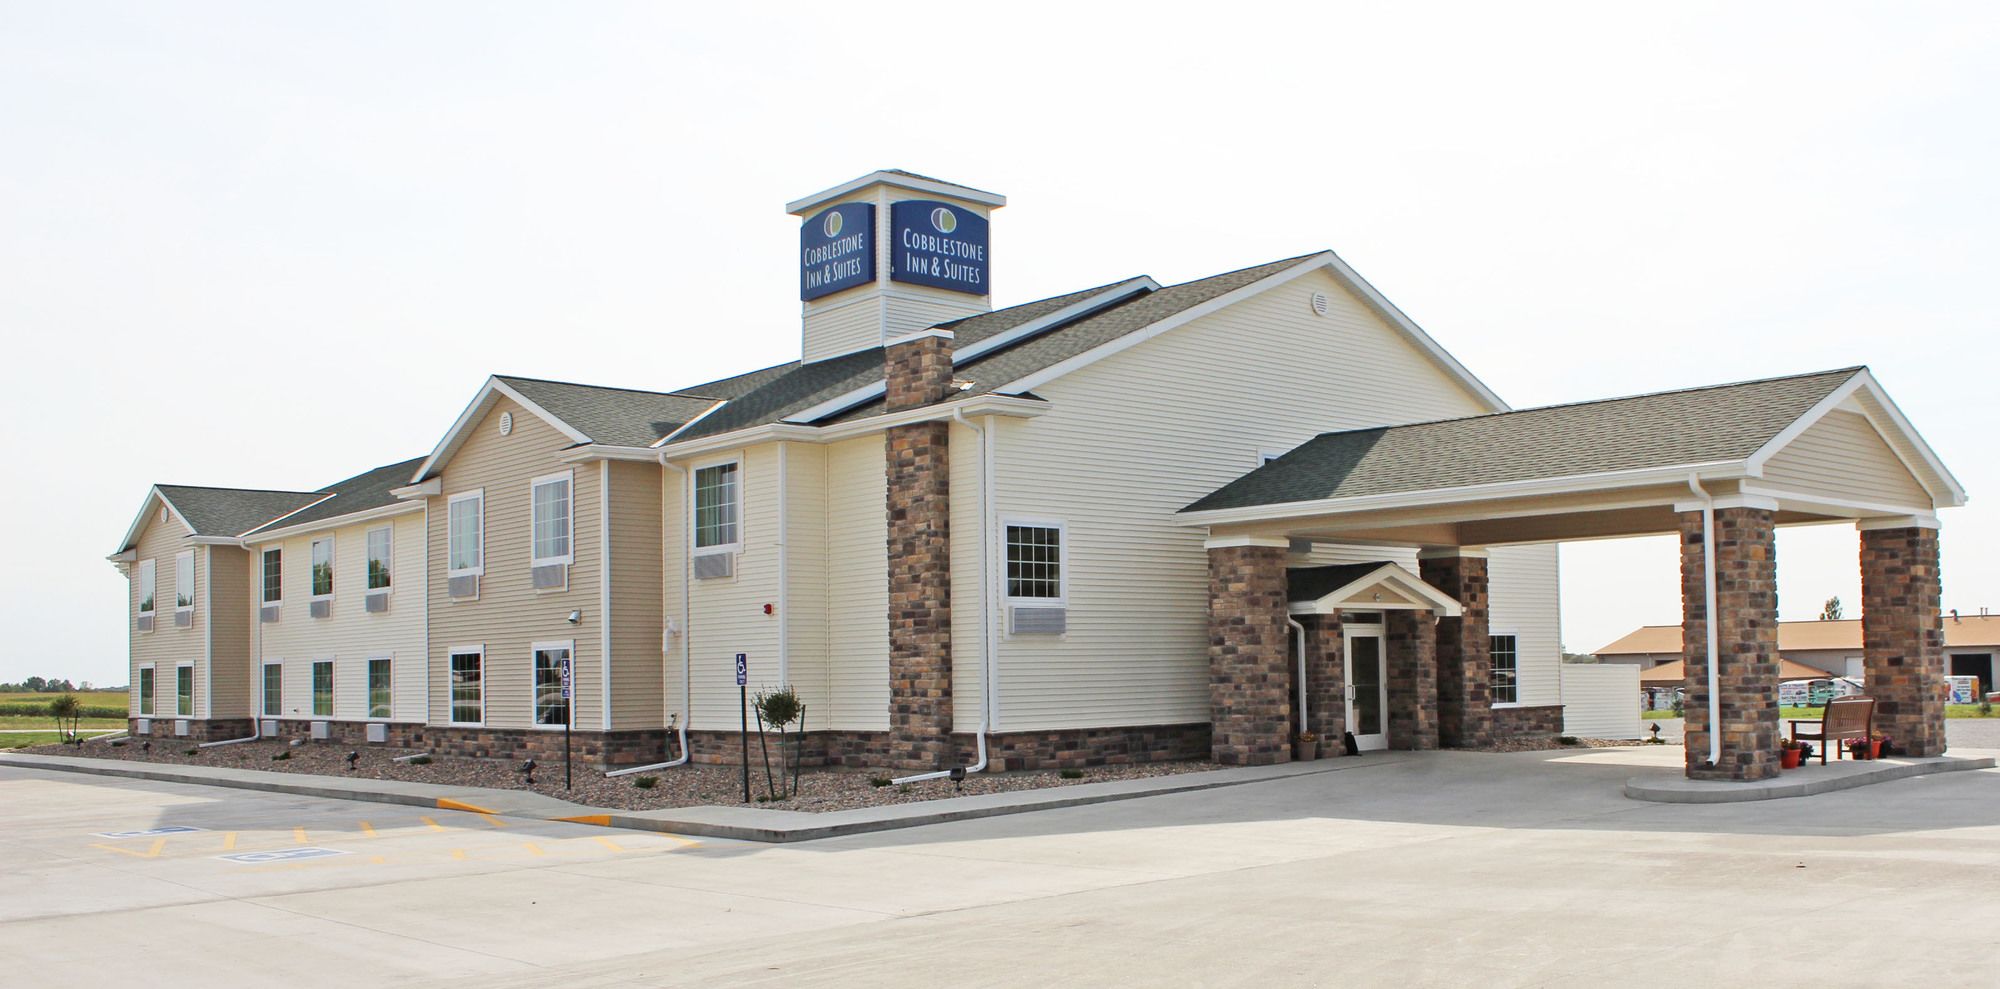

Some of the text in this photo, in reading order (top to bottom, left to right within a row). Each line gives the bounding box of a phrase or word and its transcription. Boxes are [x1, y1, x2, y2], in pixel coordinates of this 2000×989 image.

[804, 233, 863, 267] COBBLESTONE
[903, 228, 983, 261] COBBLESTONE
[806, 257, 861, 290] INN & SUITES
[906, 252, 980, 284] INN & SUITES
